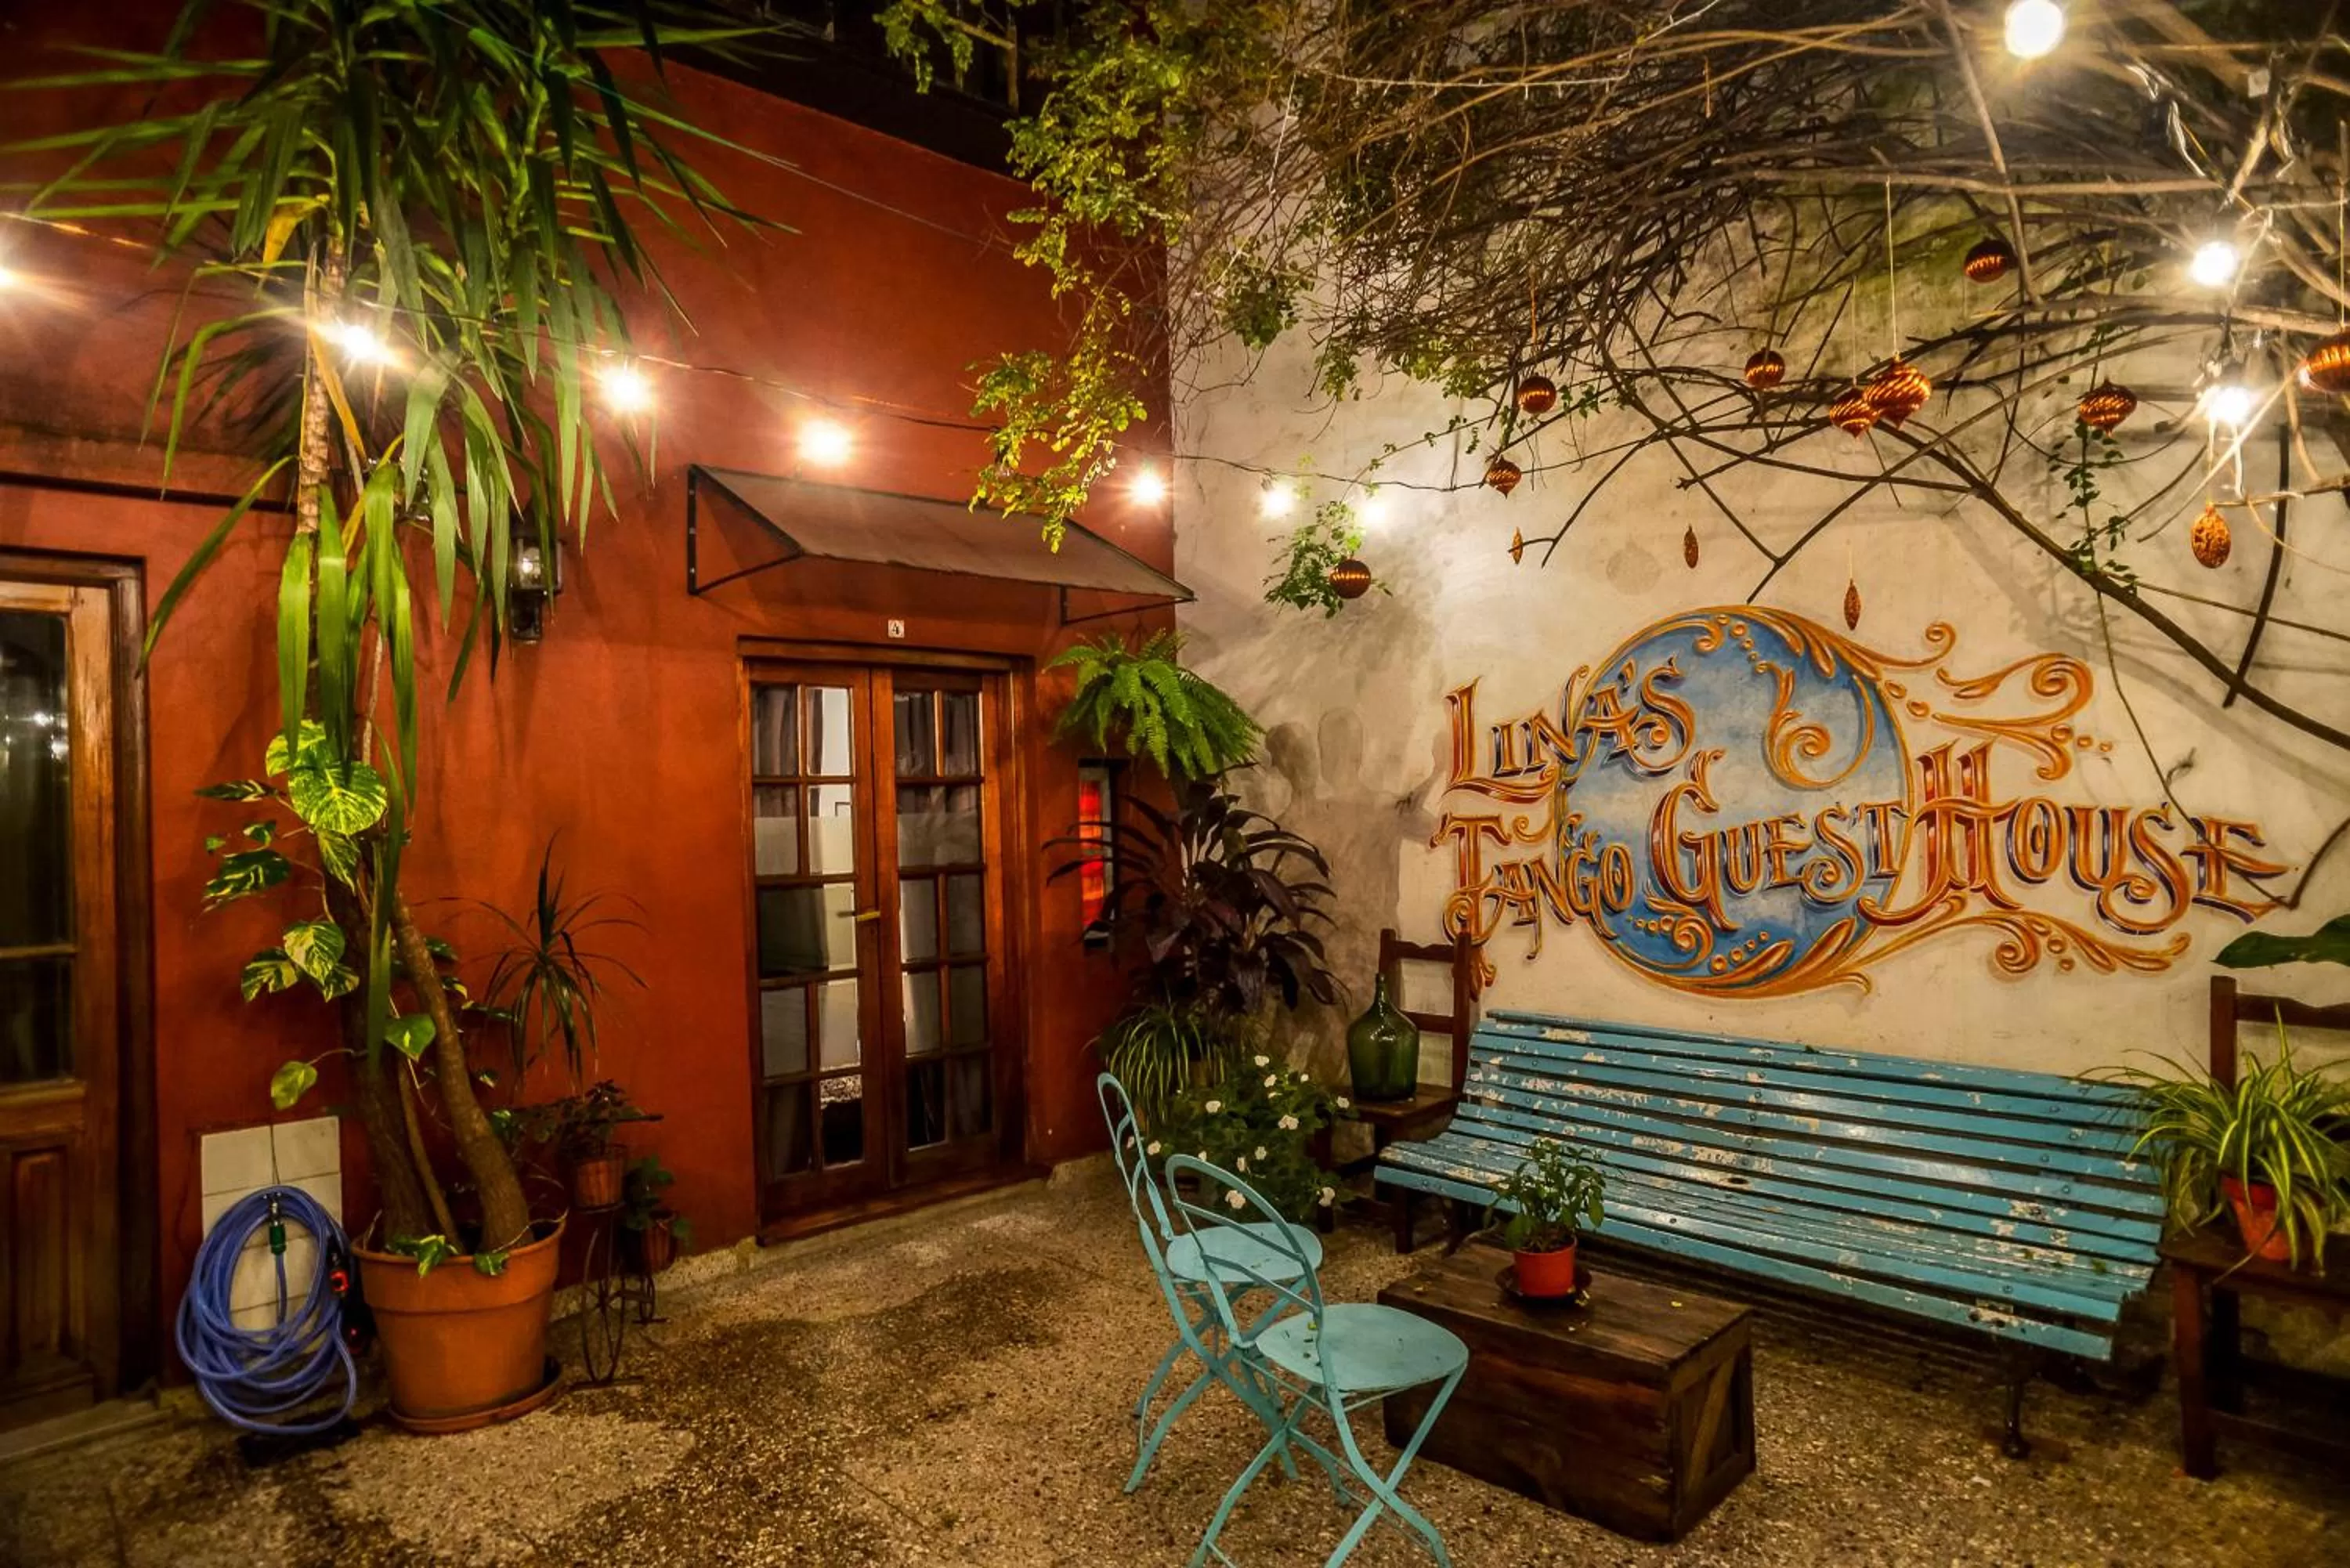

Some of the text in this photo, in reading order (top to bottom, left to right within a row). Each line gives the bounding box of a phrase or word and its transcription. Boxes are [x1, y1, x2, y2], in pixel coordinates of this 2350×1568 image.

[1441, 650, 1696, 805] LINA'S
[1430, 735, 2291, 960] TANGO GUEST HOUSE
